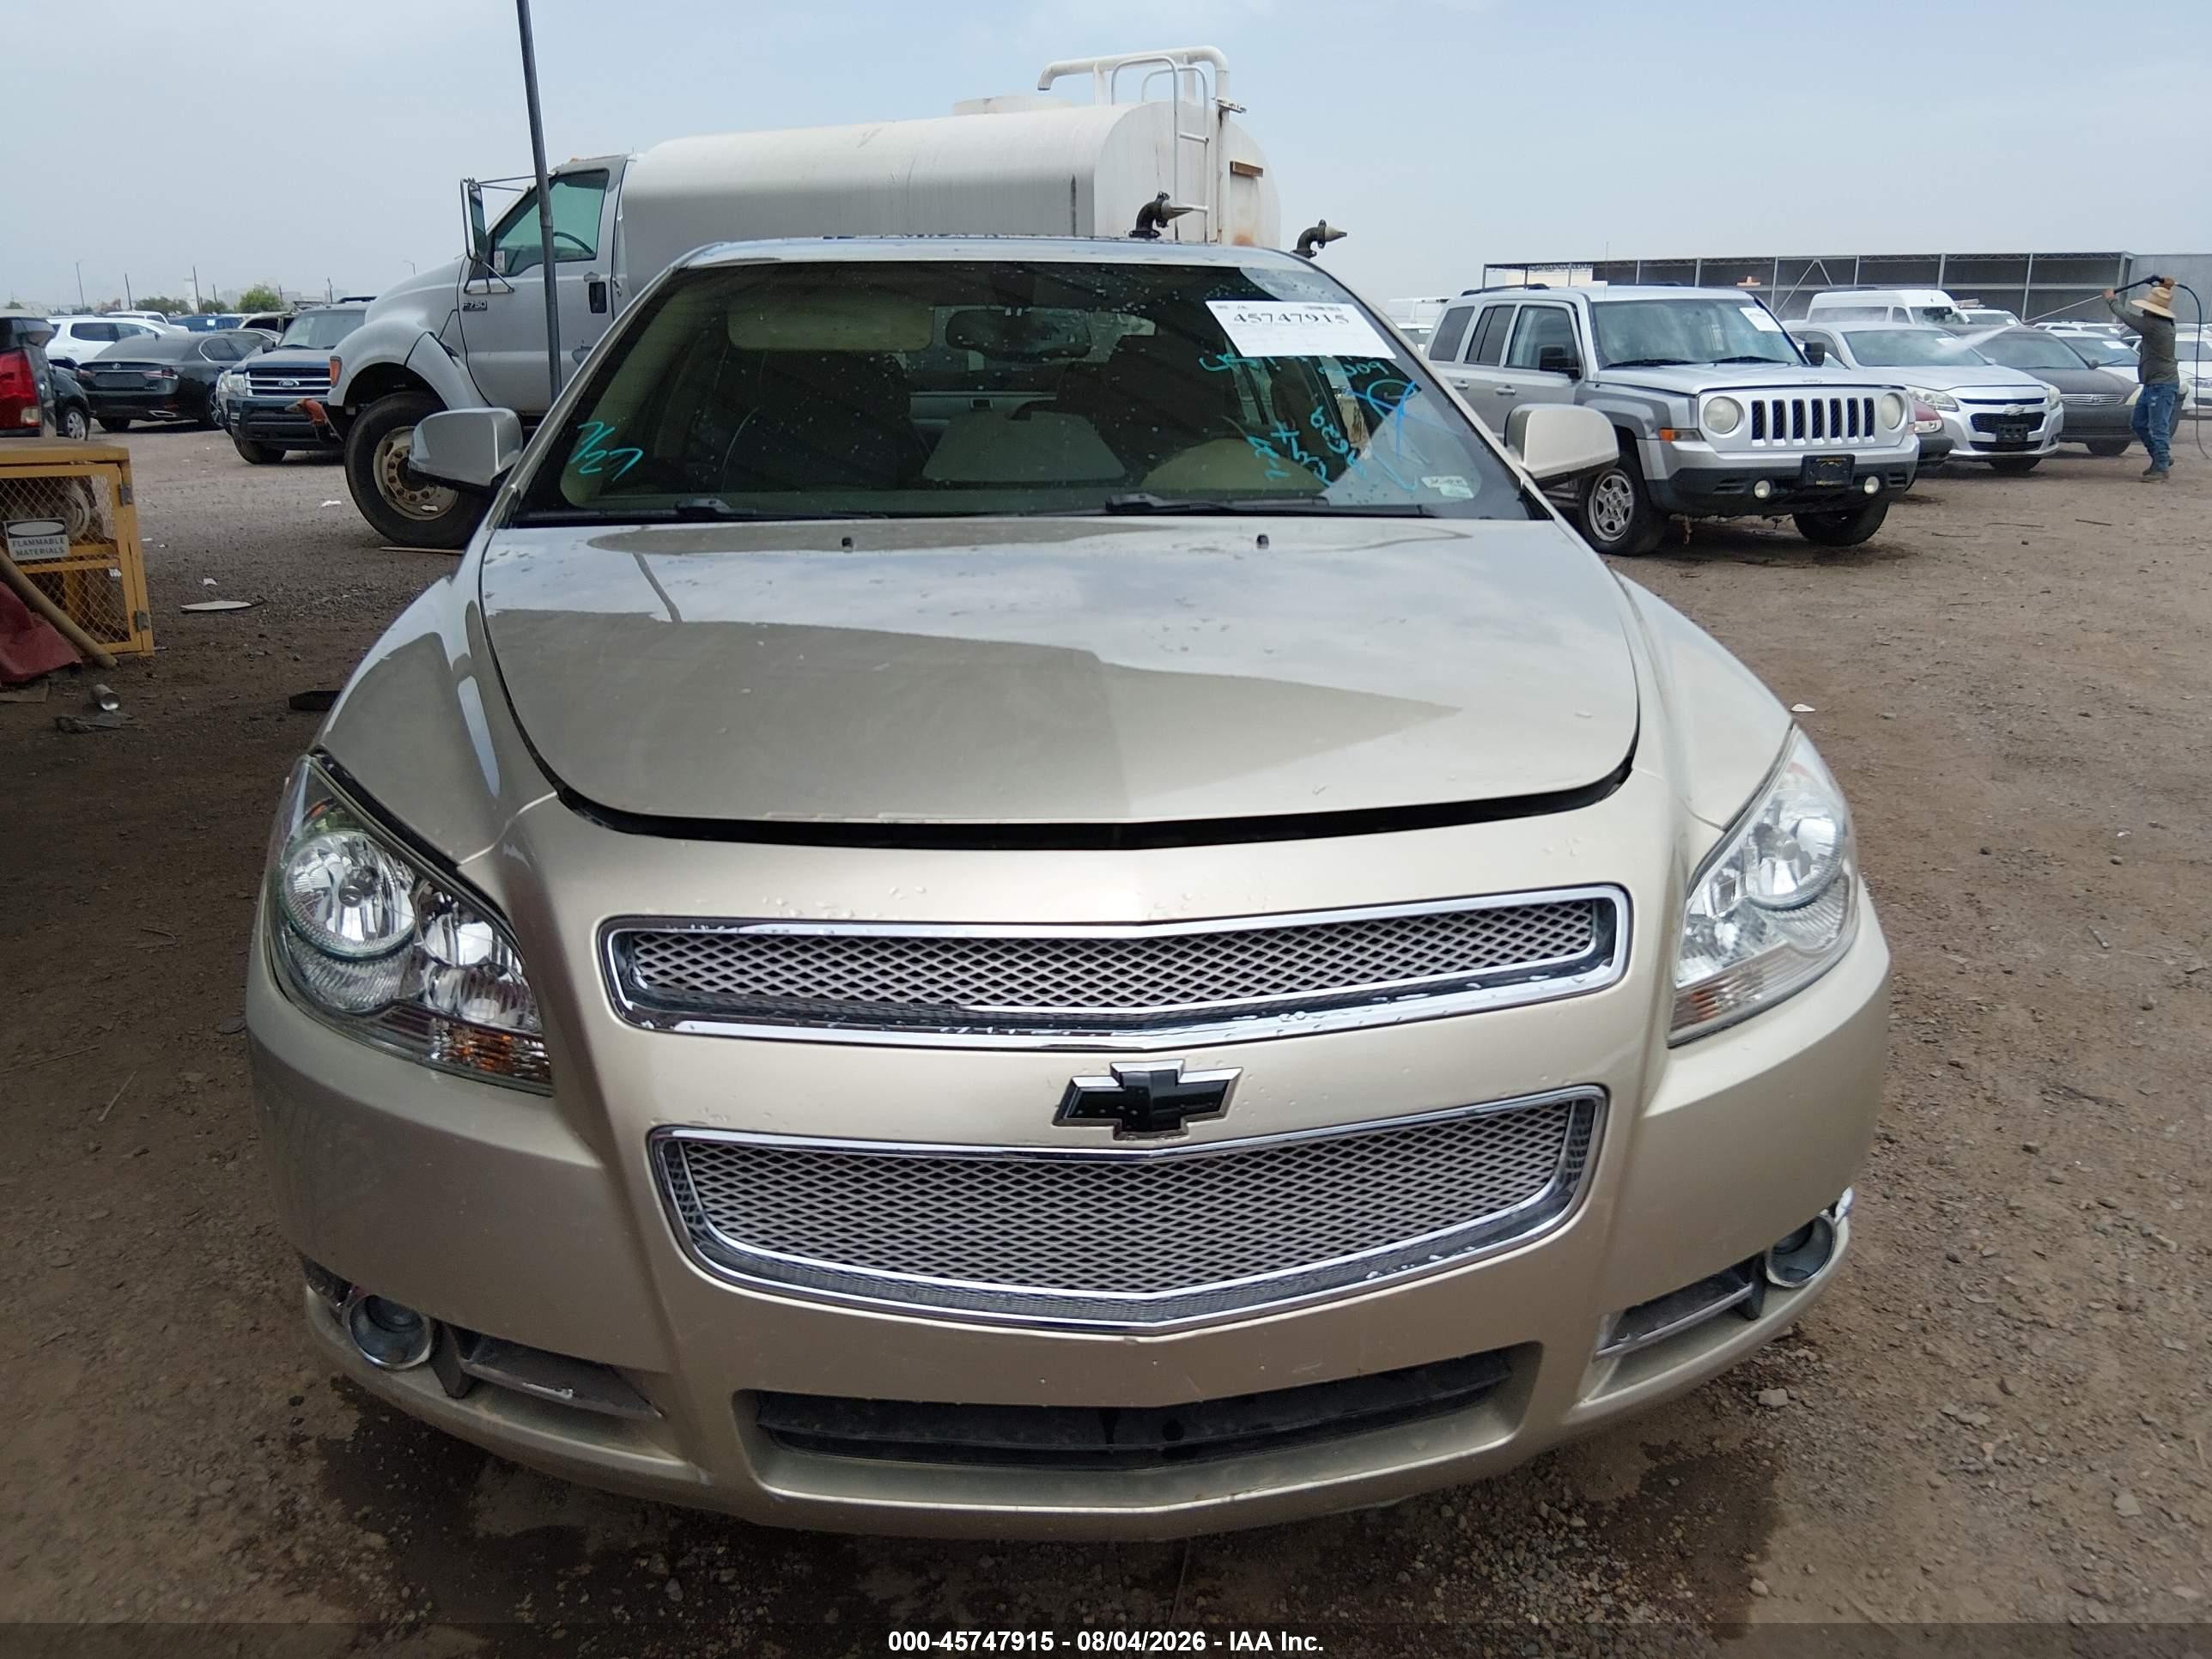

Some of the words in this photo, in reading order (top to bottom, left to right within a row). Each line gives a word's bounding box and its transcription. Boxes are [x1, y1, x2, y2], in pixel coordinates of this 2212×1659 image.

[1233, 313, 1350, 324] 45747915
[12, 537, 65, 548] FLAMMABLE
[15, 546, 64, 557] MATERIALS
